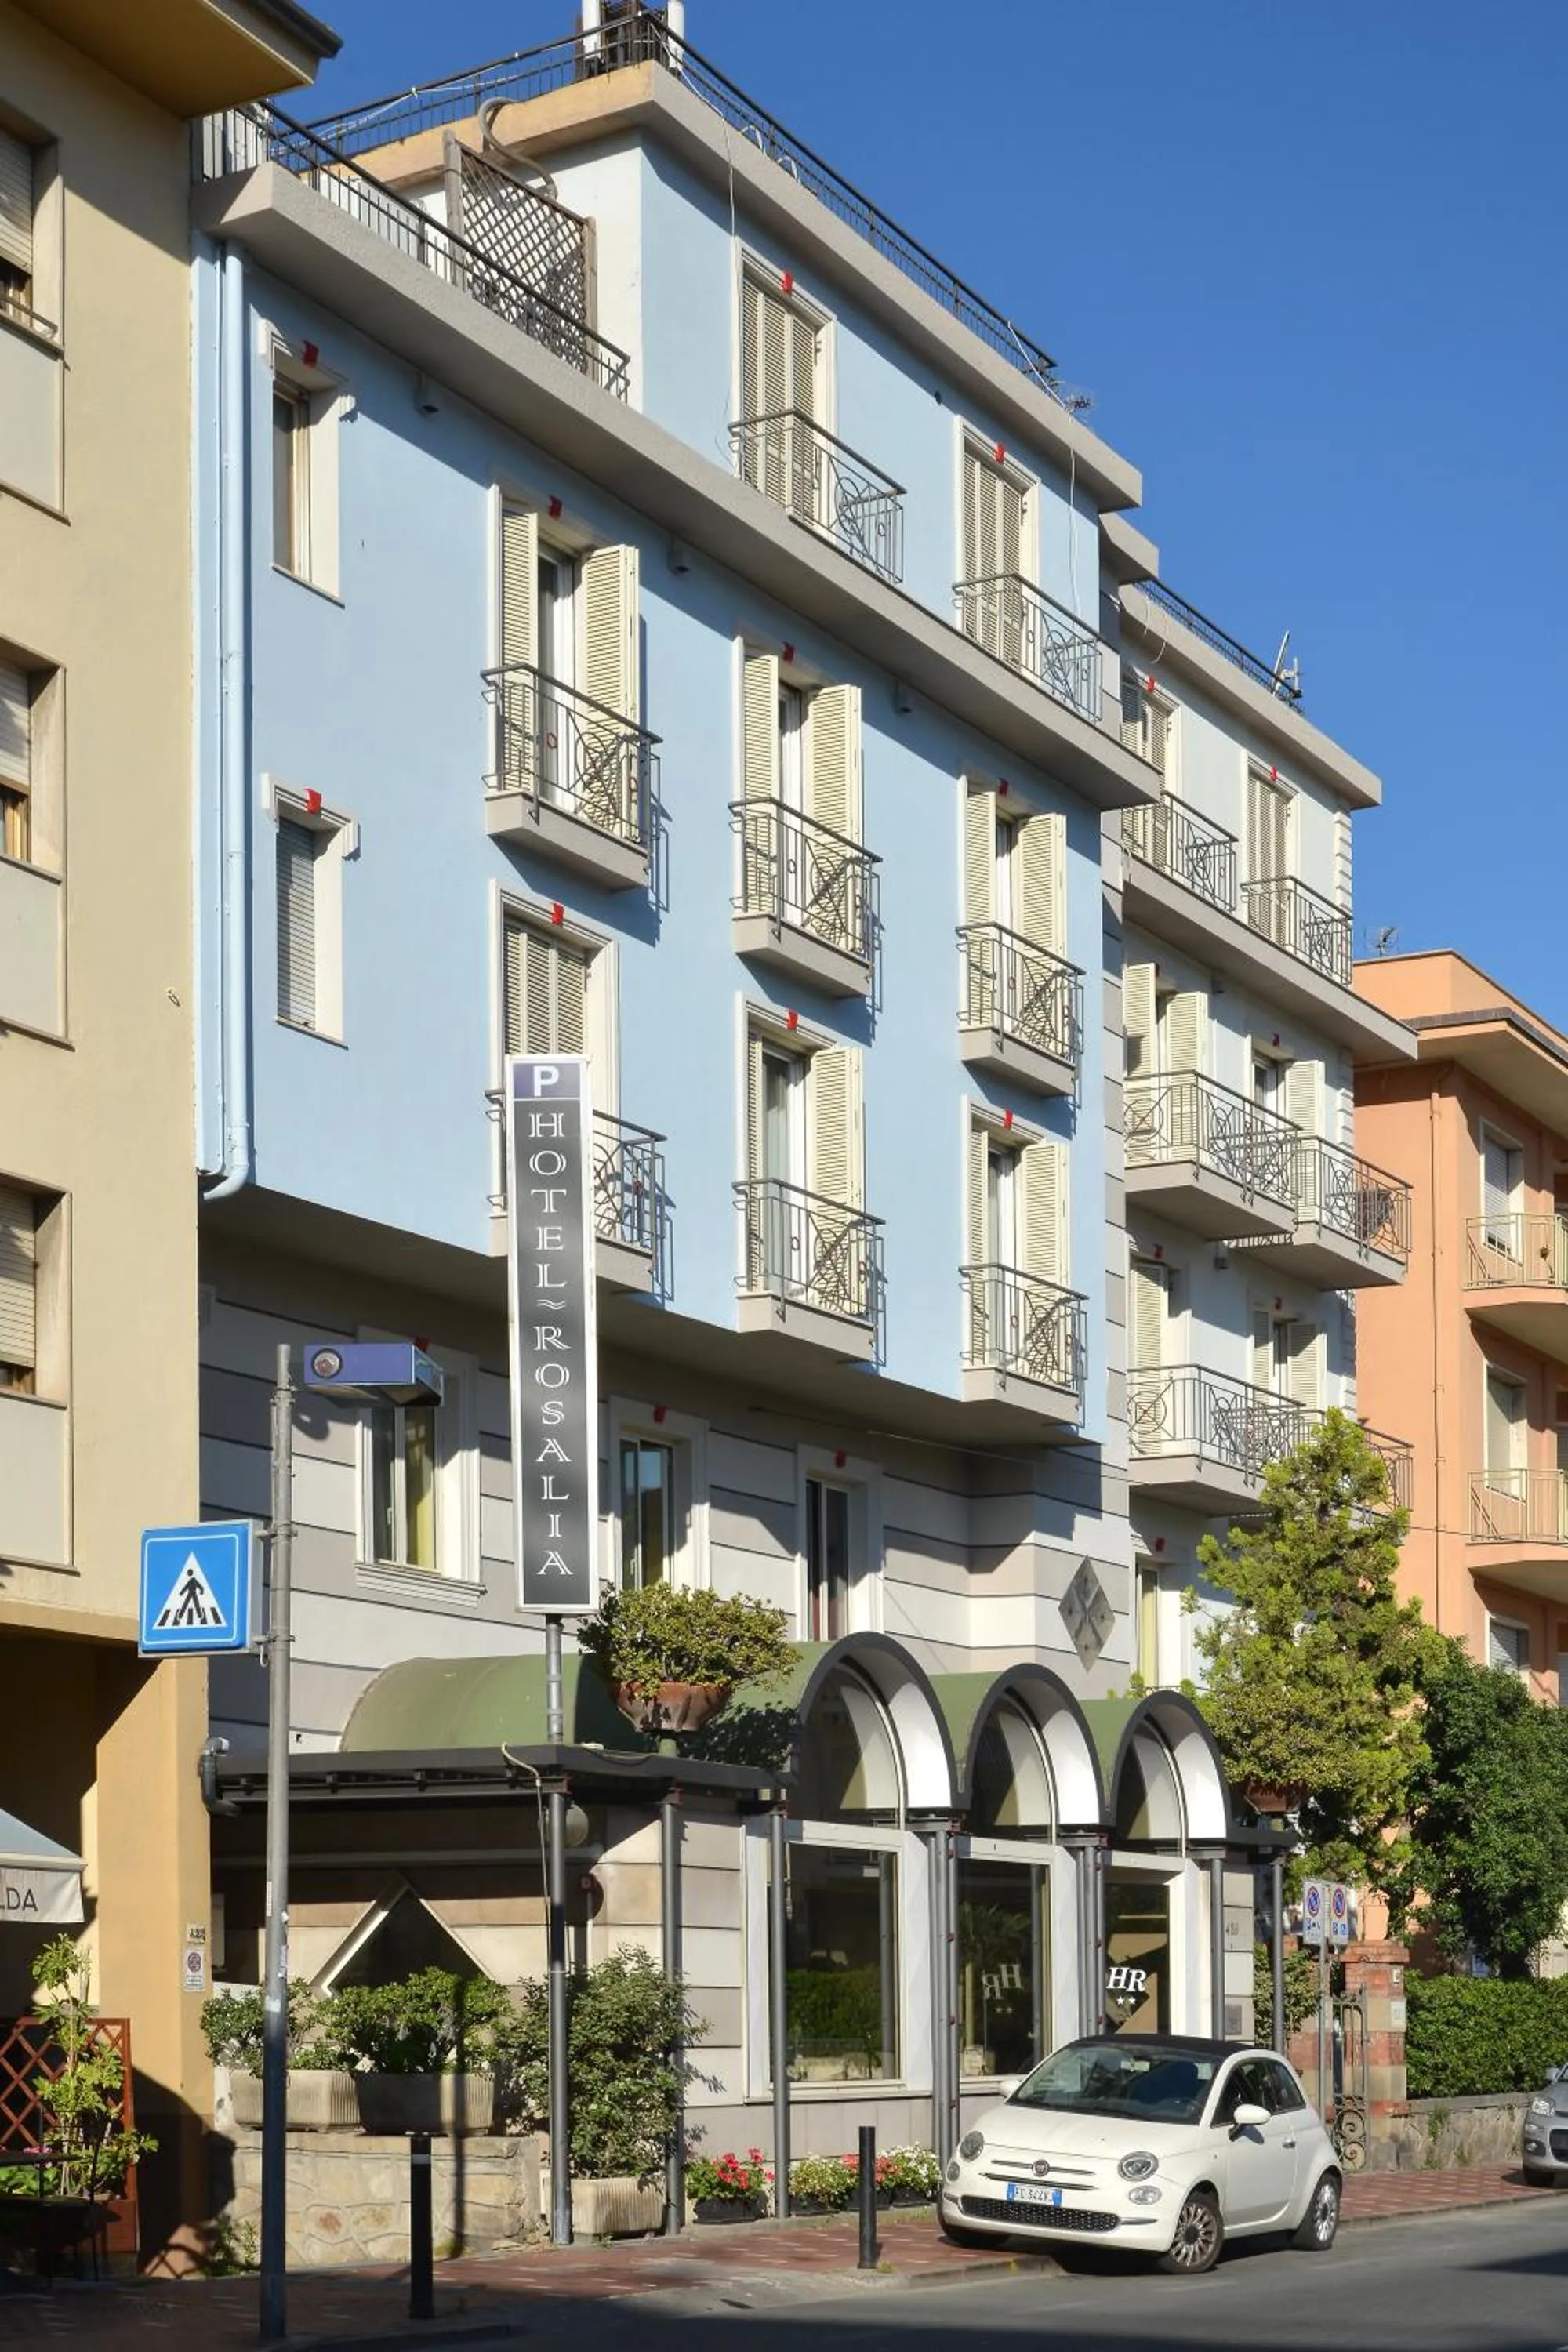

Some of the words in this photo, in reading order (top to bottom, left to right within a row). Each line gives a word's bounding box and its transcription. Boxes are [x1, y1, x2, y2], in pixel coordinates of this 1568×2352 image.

[532, 1065, 559, 1097] P
[528, 1112, 567, 1288] HOTEL
[534, 1326, 574, 1575] ROSALIA
[1105, 1966, 1147, 1992] HR
